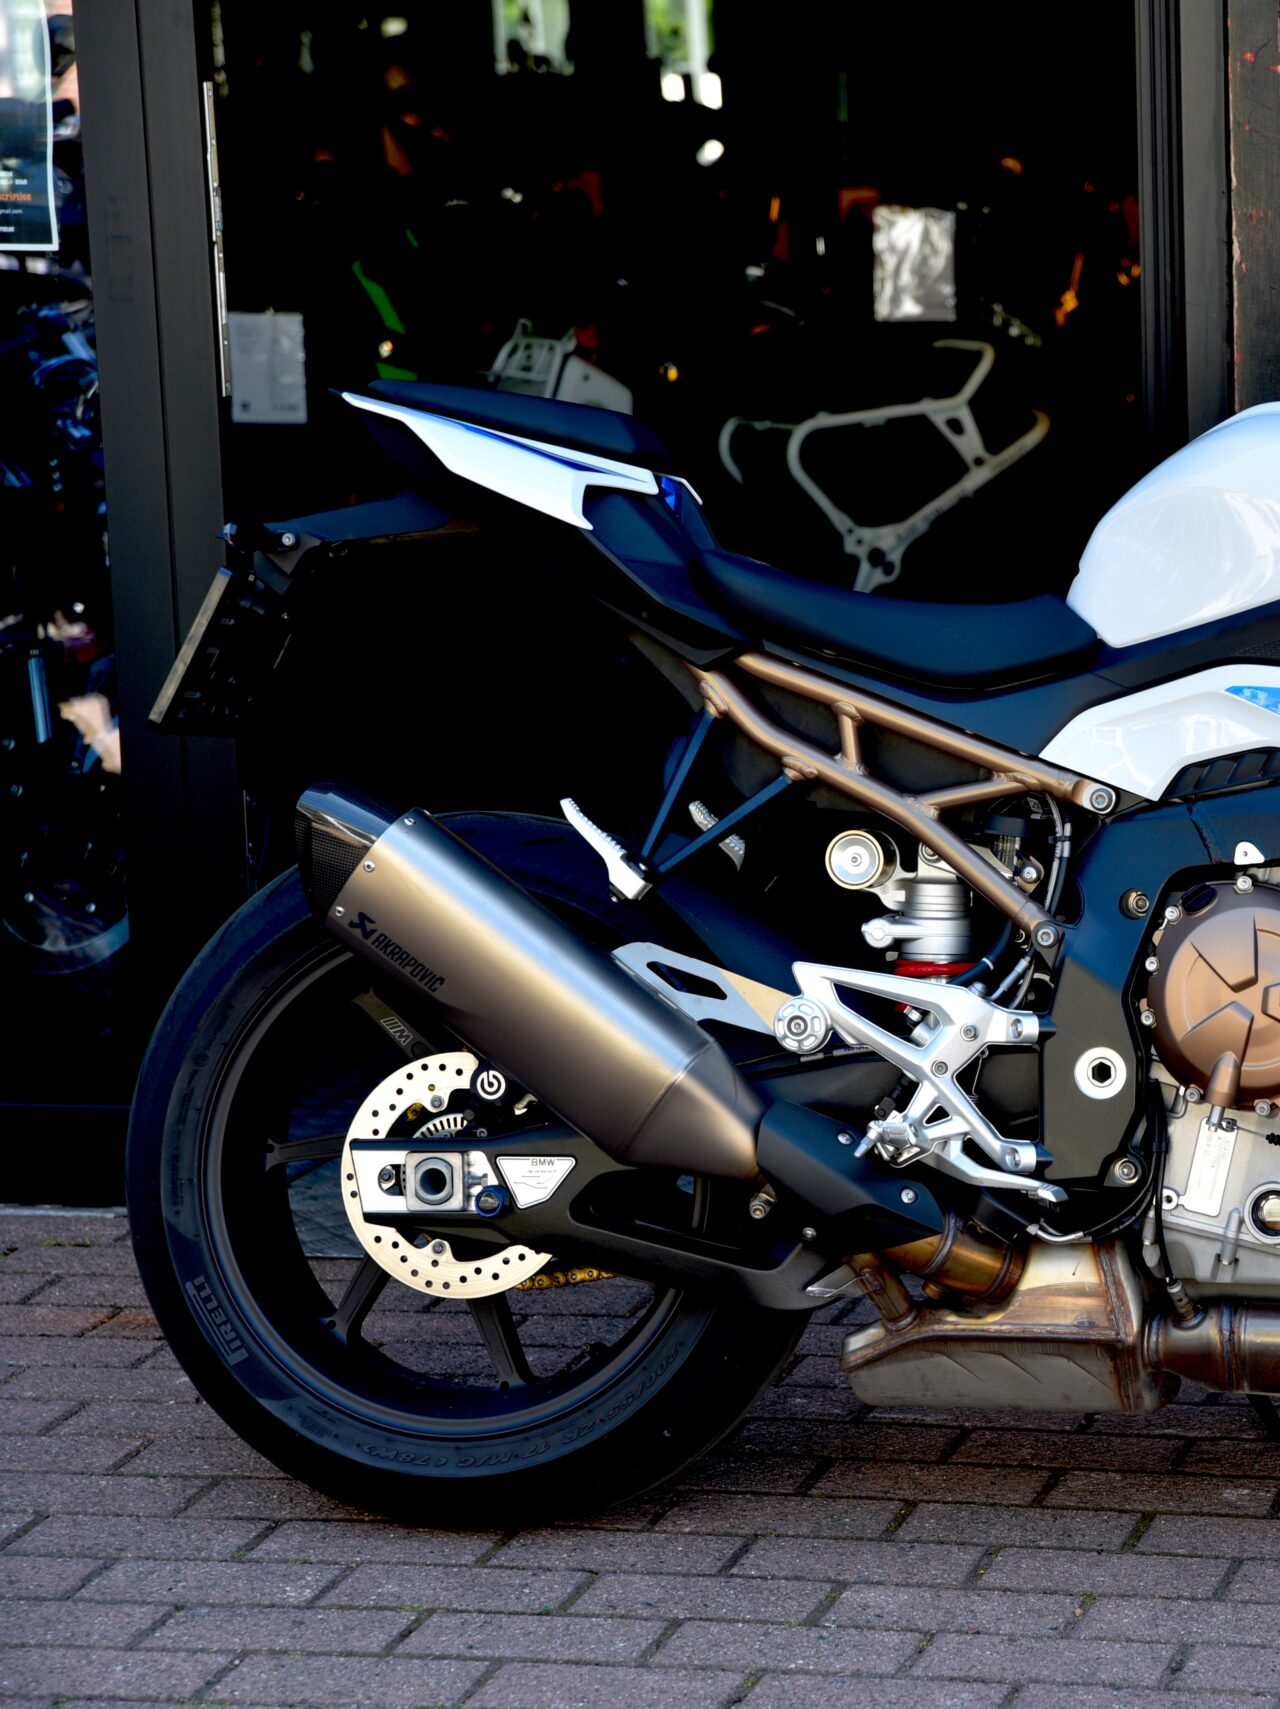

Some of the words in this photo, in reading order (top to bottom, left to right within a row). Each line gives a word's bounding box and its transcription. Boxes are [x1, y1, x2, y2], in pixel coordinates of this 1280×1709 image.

[371, 932, 446, 993] AKRAPOVIC
[530, 1158, 556, 1167] BMW
[185, 1275, 249, 1367] PIRELLI
